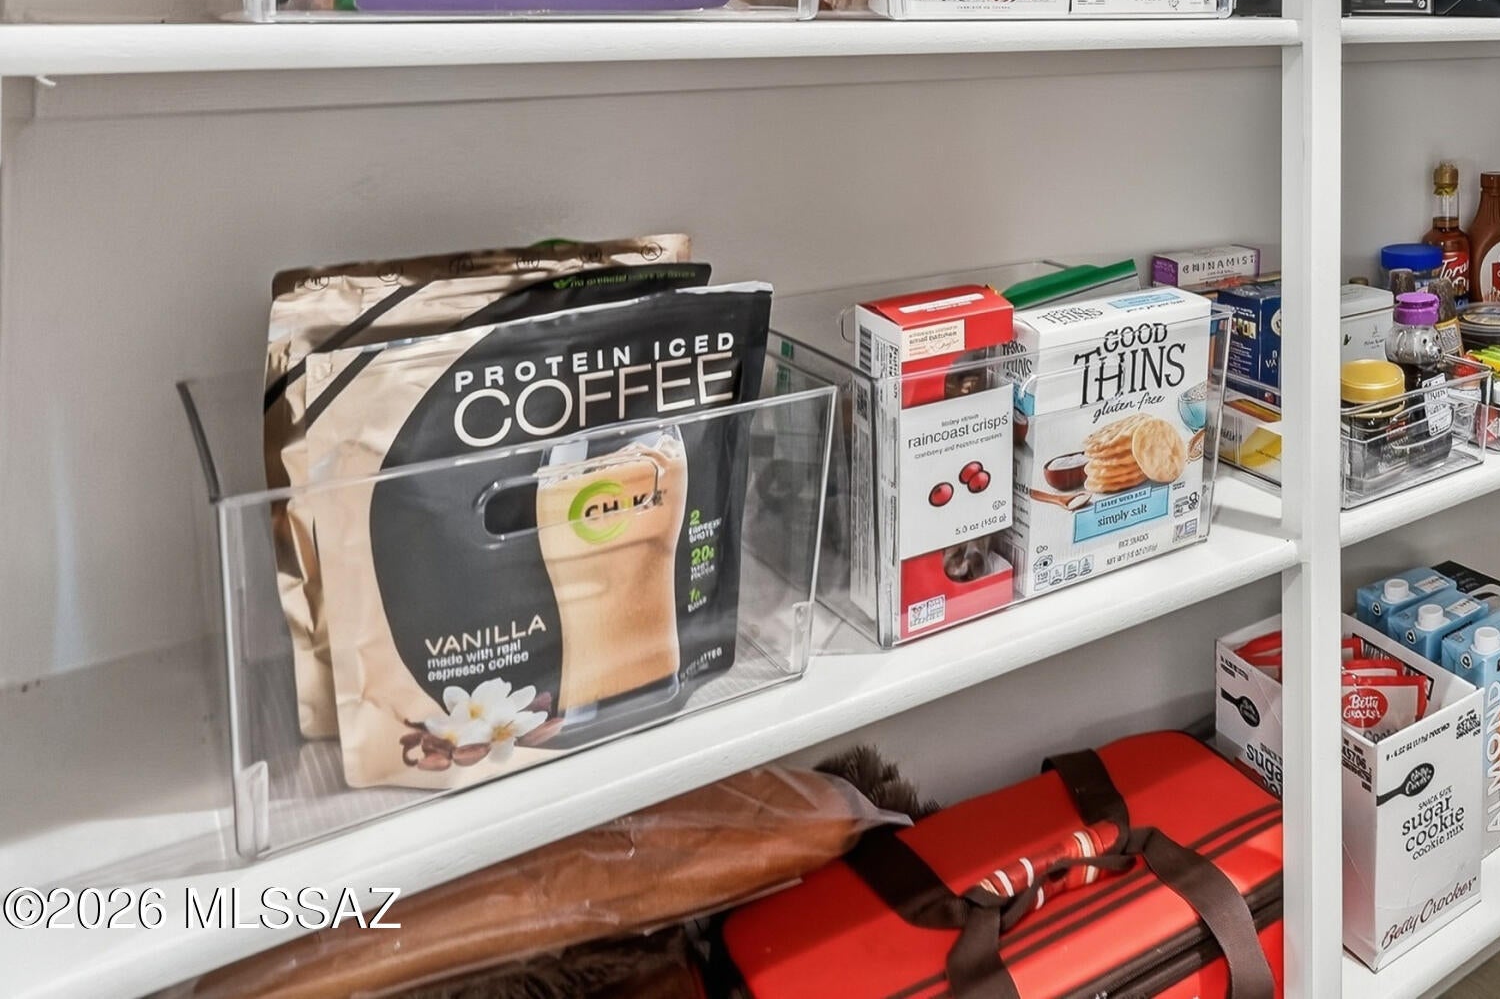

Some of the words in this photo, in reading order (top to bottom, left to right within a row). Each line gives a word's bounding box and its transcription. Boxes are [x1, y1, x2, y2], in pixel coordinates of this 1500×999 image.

[1103, 322, 1168, 352] GOOD
[454, 345, 632, 393] PROTEIN
[653, 332, 735, 362] ICED
[1073, 342, 1187, 410] THINS
[453, 351, 734, 448] COFFEE
[907, 425, 970, 451] raincoast
[971, 413, 1009, 435] crisps
[689, 509, 701, 526] 2
[424, 613, 548, 657] VANILLA
[427, 654, 464, 671] made
[465, 646, 494, 664] with
[495, 638, 522, 660] real
[427, 660, 487, 683] espresso
[487, 650, 530, 672] coffee
[1348, 693, 1379, 709] Betty
[1401, 795, 1453, 837] sugar
[1405, 806, 1466, 853] cookie
[1412, 835, 1446, 861] cookie
[1445, 822, 1465, 843] mix
[1381, 912, 1420, 951] Betty
[1419, 876, 1477, 924] Crocker
